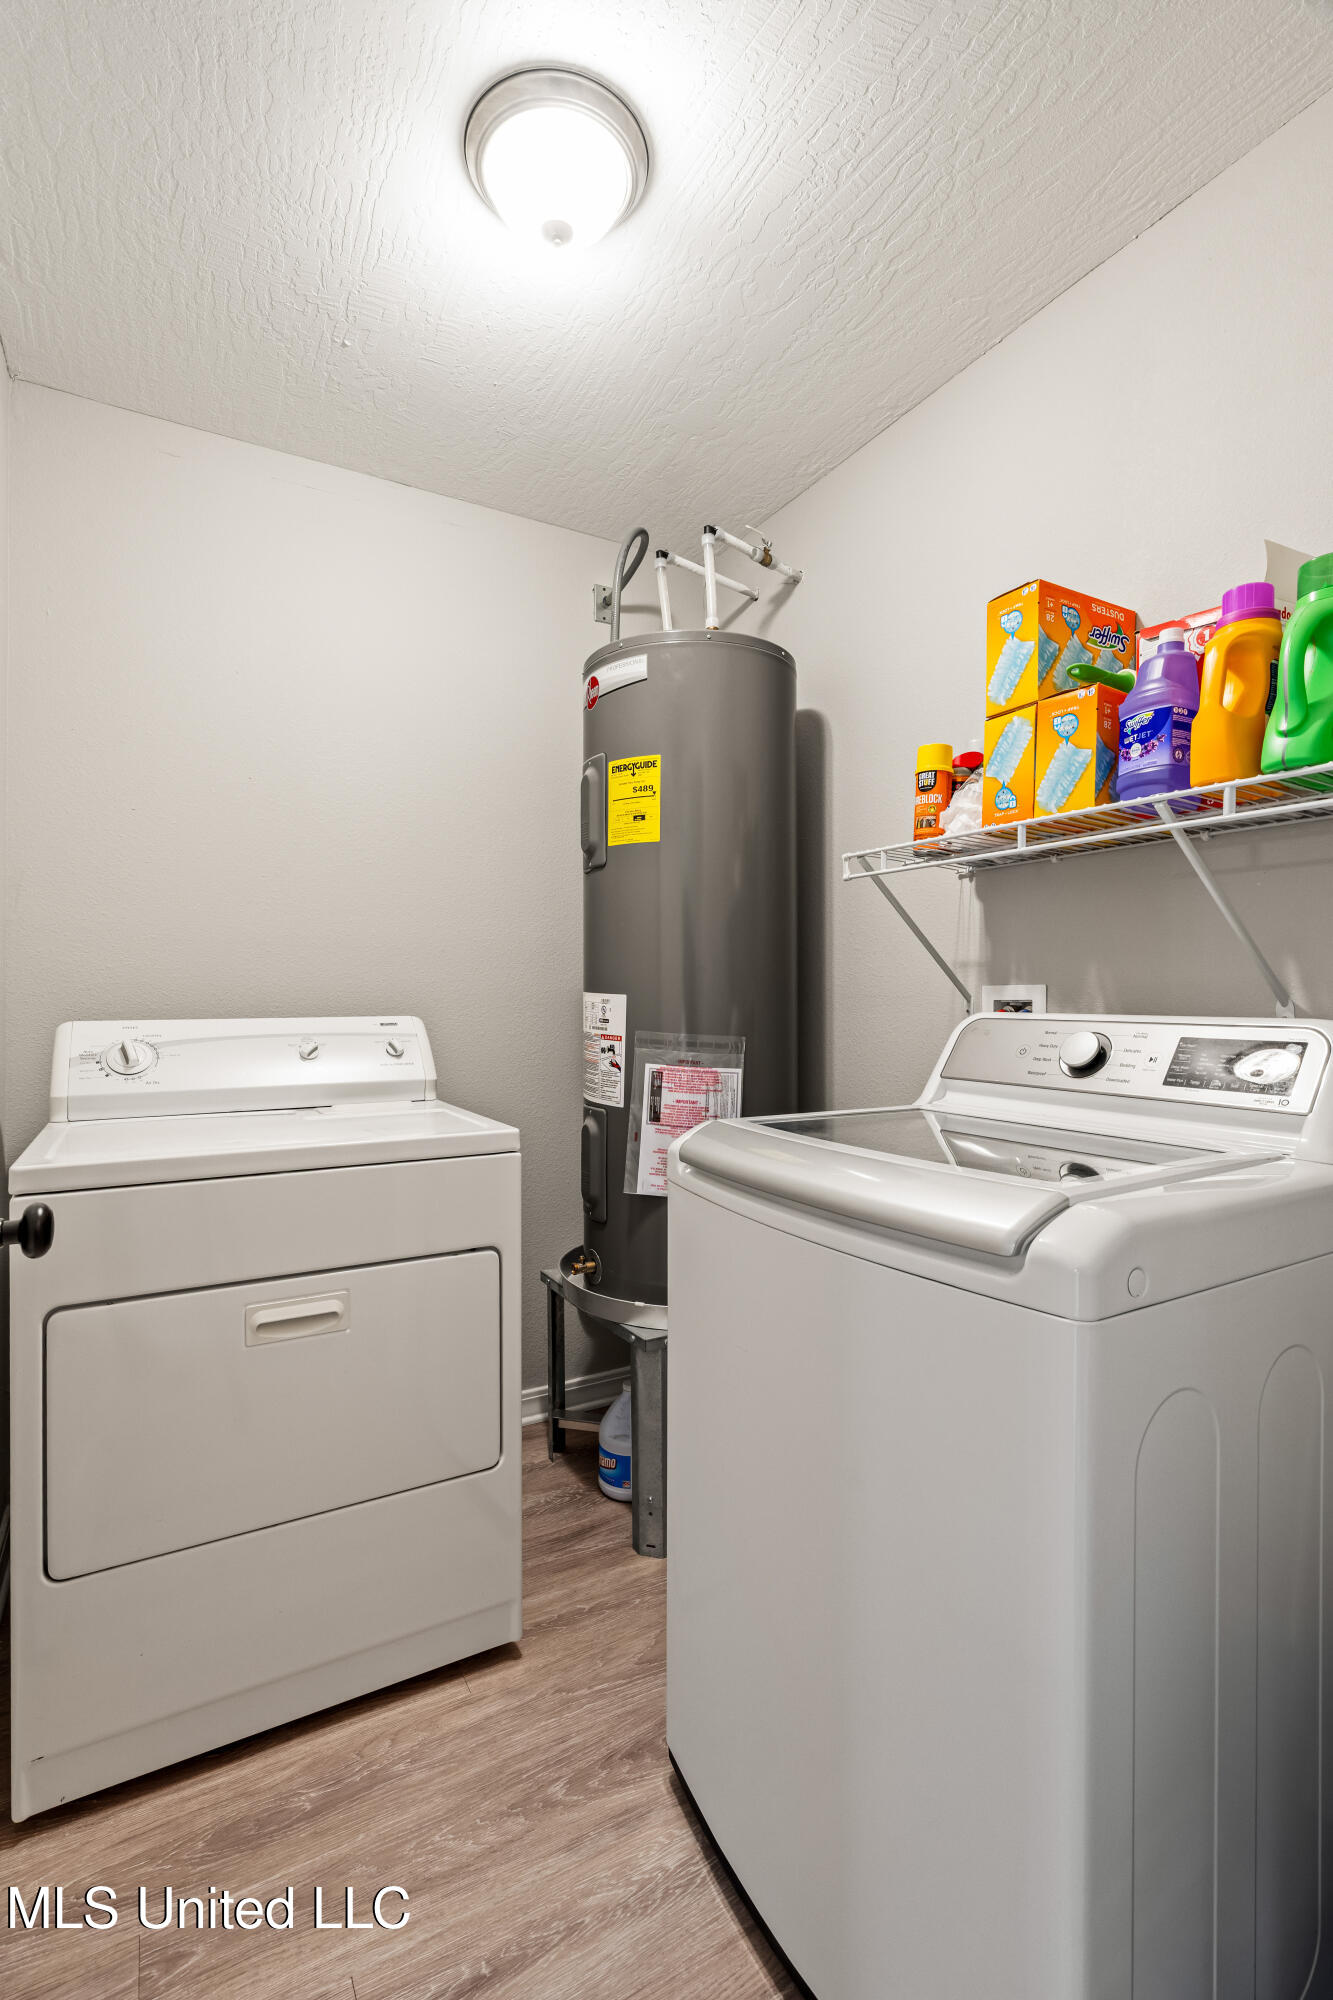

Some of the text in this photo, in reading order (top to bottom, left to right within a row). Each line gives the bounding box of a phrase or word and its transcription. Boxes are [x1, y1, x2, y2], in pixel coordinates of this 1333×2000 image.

[1091, 602, 1125, 621] DUSTERS
[1088, 625, 1131, 653] Swiffer
[1124, 713, 1153, 732] Swiffer
[611, 760, 658, 774] ENERGYGUIDE
[918, 779, 935, 788] STUFF
